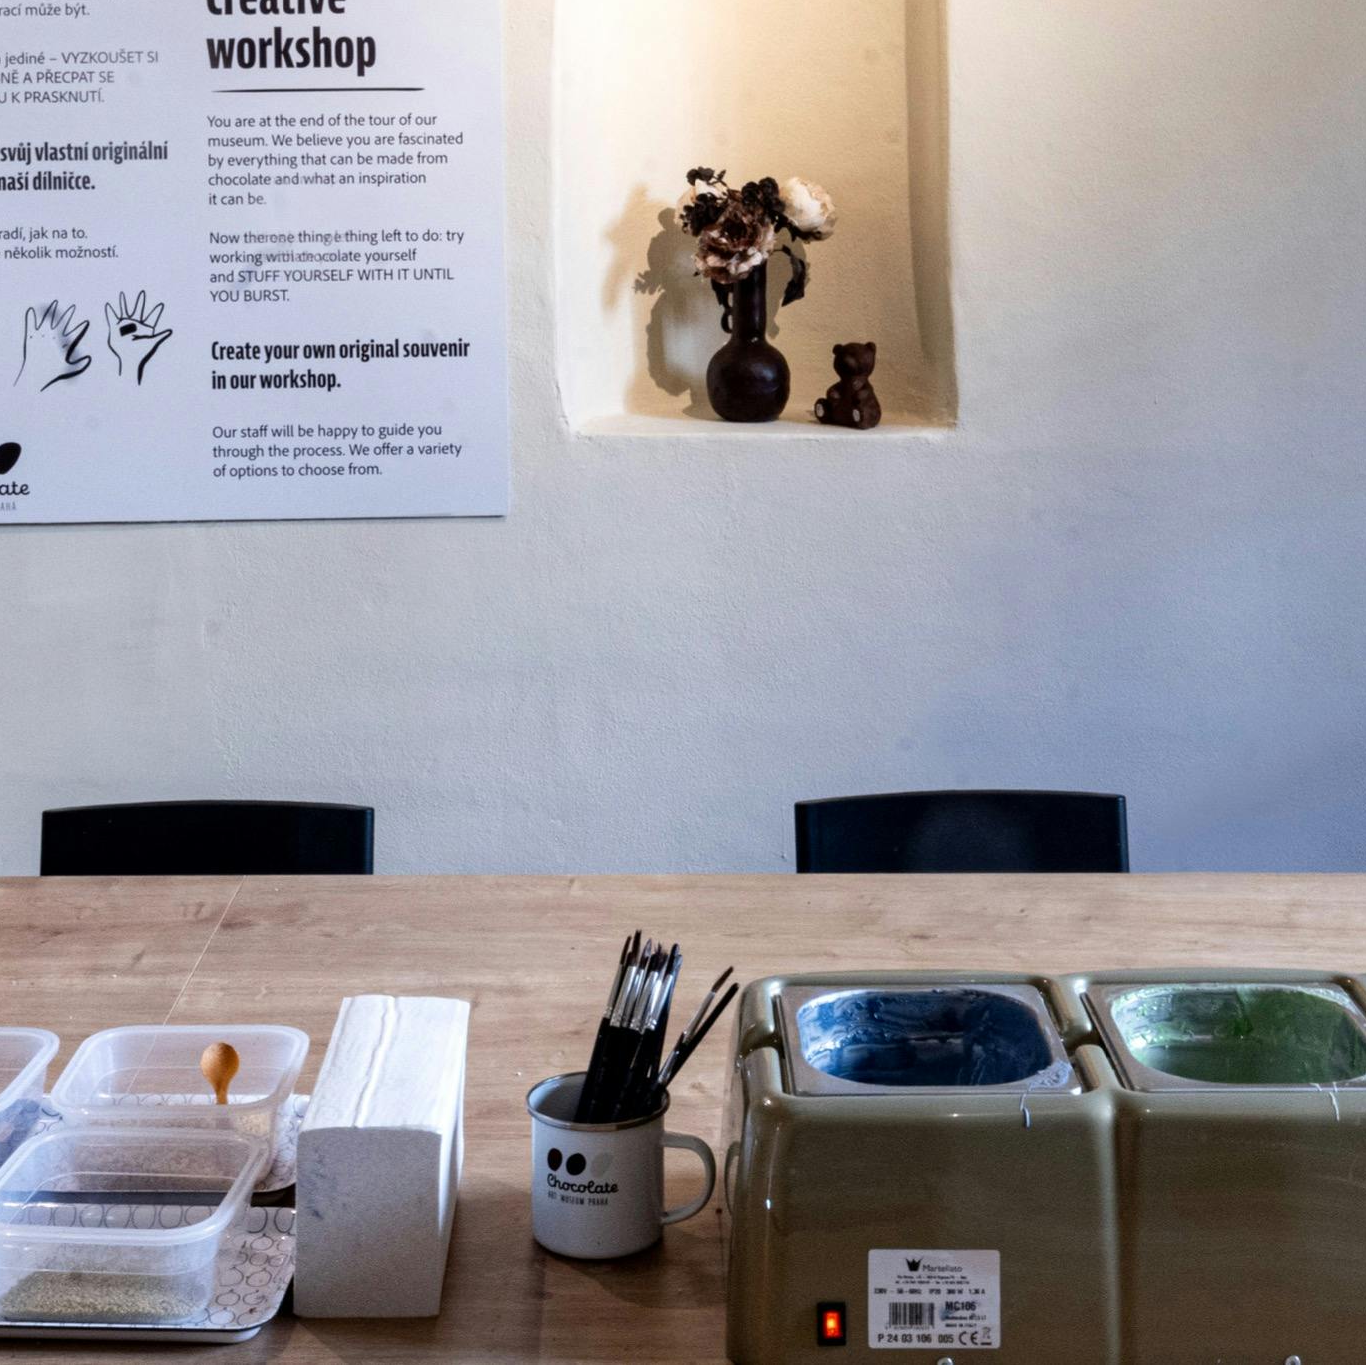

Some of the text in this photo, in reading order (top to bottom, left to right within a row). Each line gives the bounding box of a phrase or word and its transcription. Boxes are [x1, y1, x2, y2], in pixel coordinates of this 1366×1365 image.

[25, 3, 61, 16] může
[65, 3, 90, 19] být.
[4, 52, 45, 69] jediné
[61, 49, 144, 64] VYZKOUŠET
[147, 51, 158, 63] SI
[206, 26, 376, 77] workshop
[23, 72, 33, 83] A
[36, 69, 95, 83] PŘECPAT
[99, 71, 114, 83] SE
[11, 92, 20, 103] K
[24, 88, 104, 103] PRASKNUTÍ.
[207, 113, 437, 127] You are at the end of the tour of our
[208, 132, 463, 148] museum. We believe you are fascinated
[0, 142, 31, 165] svůj
[35, 142, 88, 161] vlastní
[92, 141, 168, 164] originální
[208, 151, 448, 169] by everything that can be made from
[33, 171, 95, 190] dílničce.
[208, 172, 426, 187] chocolate and what an inspiration
[209, 192, 266, 205] it can be.
[29, 227, 48, 243] jak
[52, 230, 68, 239] na
[72, 227, 87, 239] to.
[210, 232, 240, 244] Now
[382, 229, 402, 242] left
[405, 231, 419, 242] to
[422, 229, 442, 242] do:
[446, 230, 464, 244] try
[4, 246, 52, 259] několik
[55, 245, 118, 258] možností.
[209, 251, 263, 267] working
[365, 248, 417, 264] yourself
[210, 268, 454, 283] and STUFF YOURSELF WITH IT UNTIL
[210, 289, 289, 302] YOU BURST.
[212, 338, 470, 364] Create your own original souvenir
[212, 369, 341, 392] in our workshop.
[212, 423, 442, 440] Our staff will be happy to guide you
[213, 442, 462, 461] through the process. We offer a variety
[213, 462, 382, 480] of options to choose from.
[546, 1173, 620, 1194] Chocolate
[877, 1333, 884, 1343] P
[887, 1334, 898, 1344] 24
[916, 1334, 932, 1344] 106
